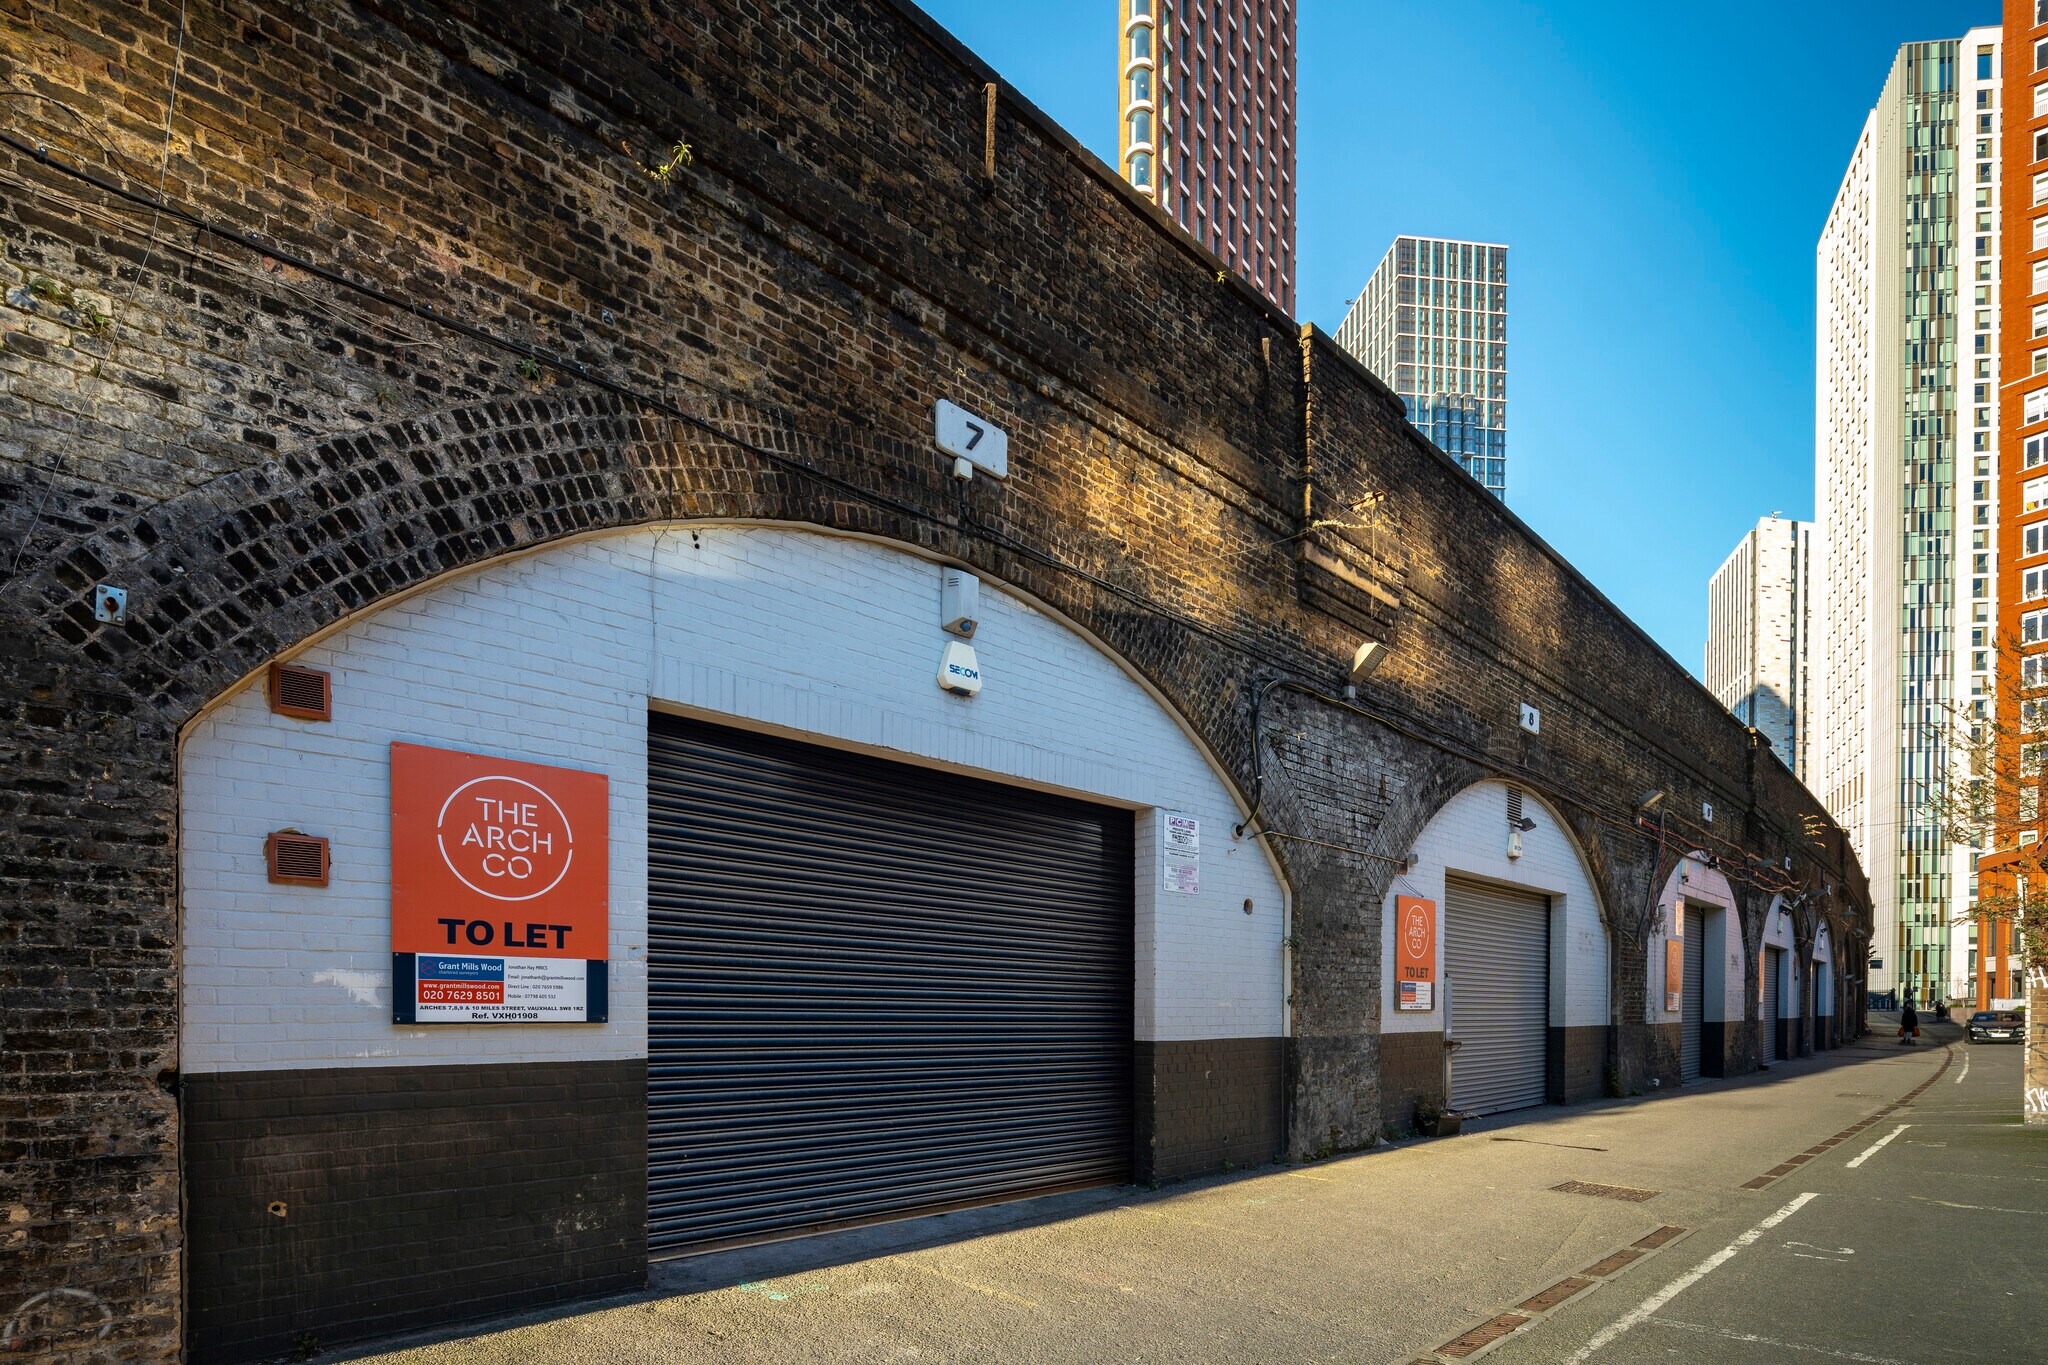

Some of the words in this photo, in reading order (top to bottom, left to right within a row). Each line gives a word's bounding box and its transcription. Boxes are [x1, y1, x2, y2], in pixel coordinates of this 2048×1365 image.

[966, 420, 984, 451] 7
[949, 664, 979, 680] SECOM
[1528, 712, 1535, 727] 8
[475, 797, 538, 827] THE
[461, 822, 552, 855] ARCH
[482, 853, 532, 879] CO
[1411, 914, 1423, 927] THE
[438, 918, 494, 946] TO
[504, 922, 573, 949] LET
[1408, 927, 1425, 938] ARCH
[1411, 938, 1422, 949] CO
[438, 961, 460, 970] Grant
[461, 962, 479, 971] Mills
[481, 963, 502, 971] Wood
[1405, 967, 1415, 977] TO
[1416, 967, 1429, 978] LET
[423, 990, 444, 1000] 020
[447, 991, 473, 1000] 7629
[475, 991, 500, 1000] 8501
